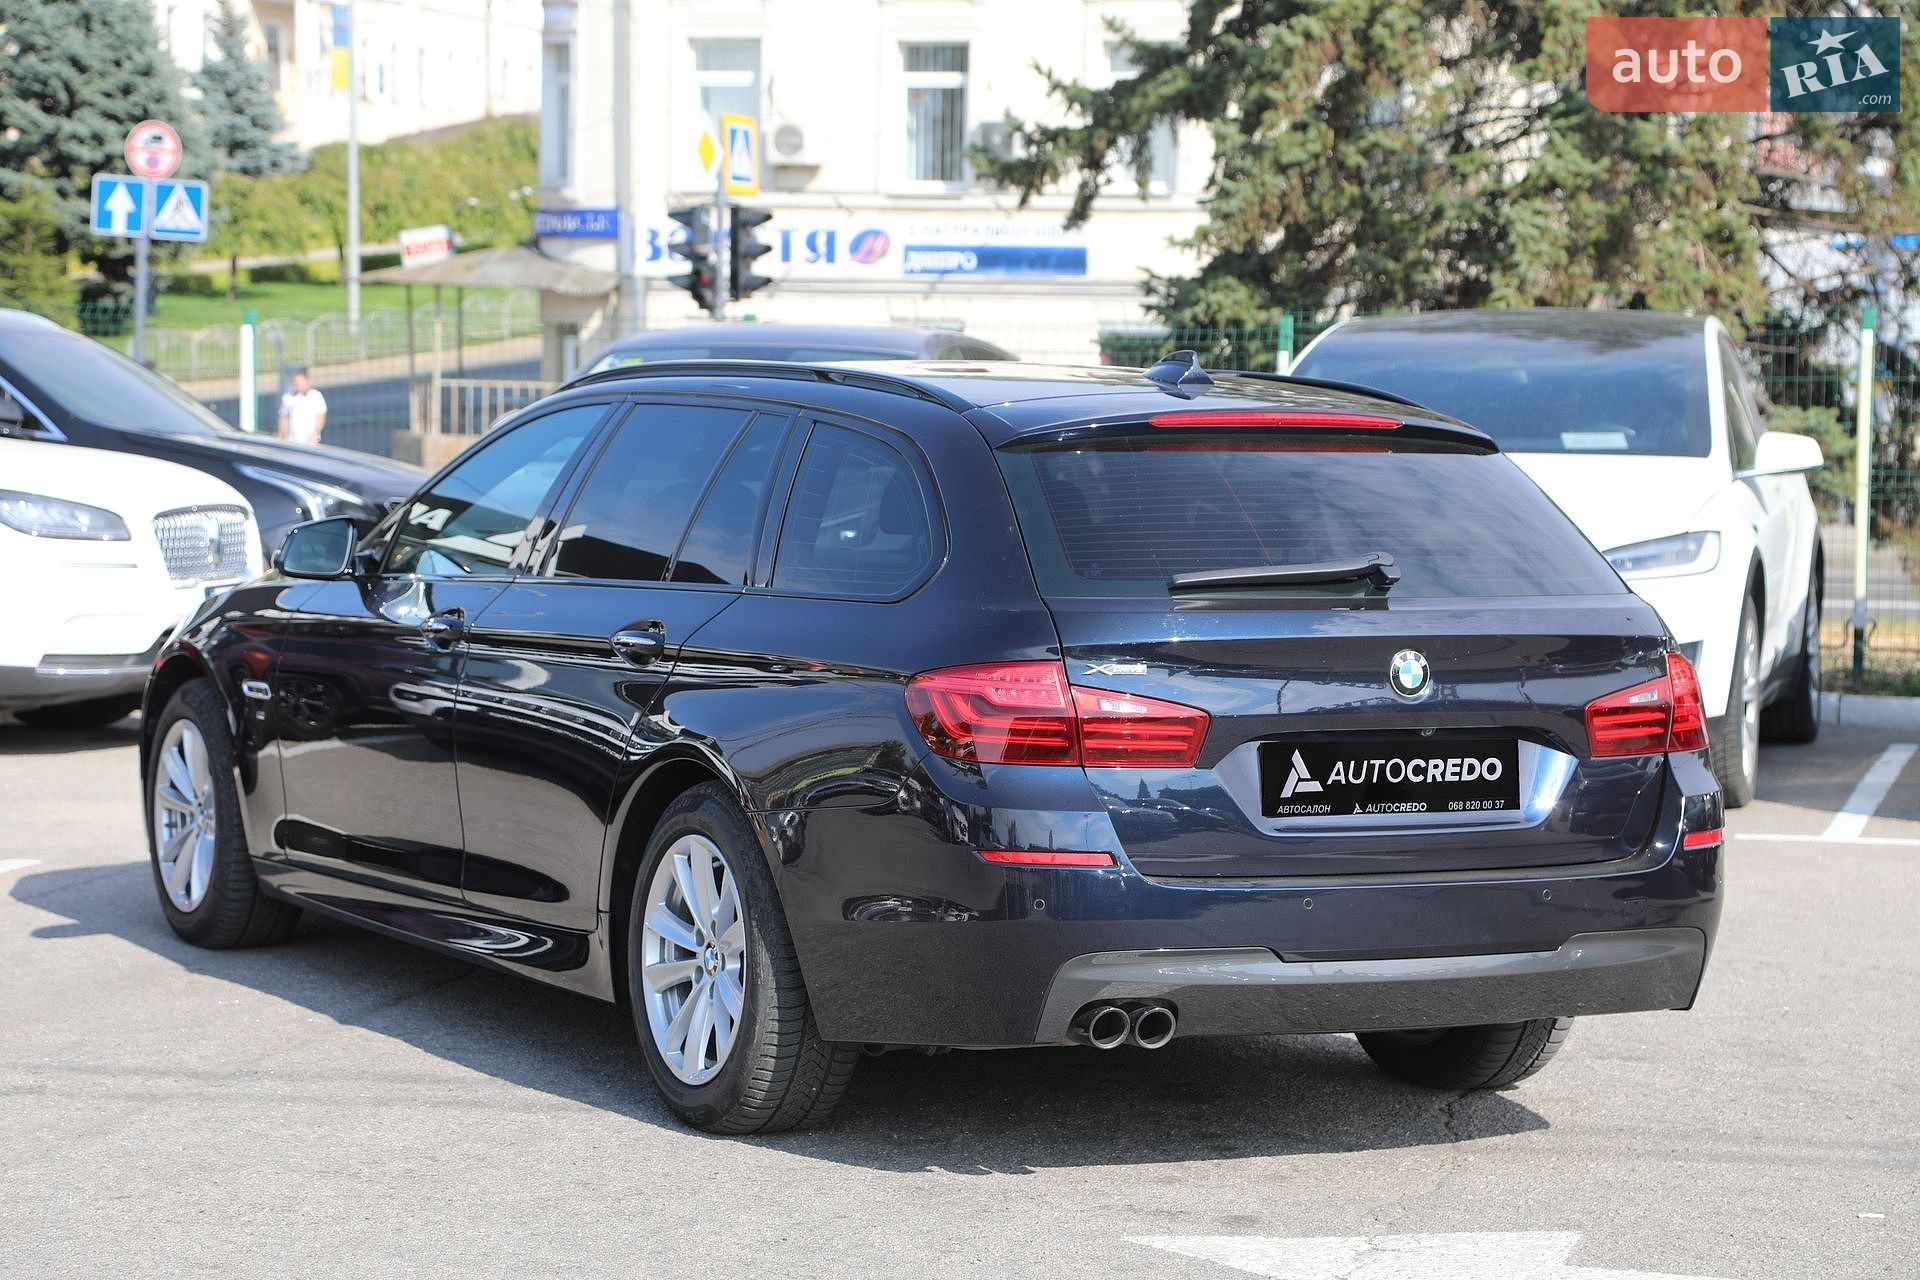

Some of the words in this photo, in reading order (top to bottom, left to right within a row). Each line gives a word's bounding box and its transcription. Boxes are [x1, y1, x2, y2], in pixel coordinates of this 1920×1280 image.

[1326, 757, 1503, 785] AUTOCREDO
[1277, 804, 1331, 814] АВТОСАЛОН
[1365, 802, 1427, 813] AUTOCREDO
[1448, 801, 1464, 811] 068
[1465, 800, 1481, 810] 820
[1482, 800, 1493, 810] 00
[1494, 799, 1505, 810] 37
